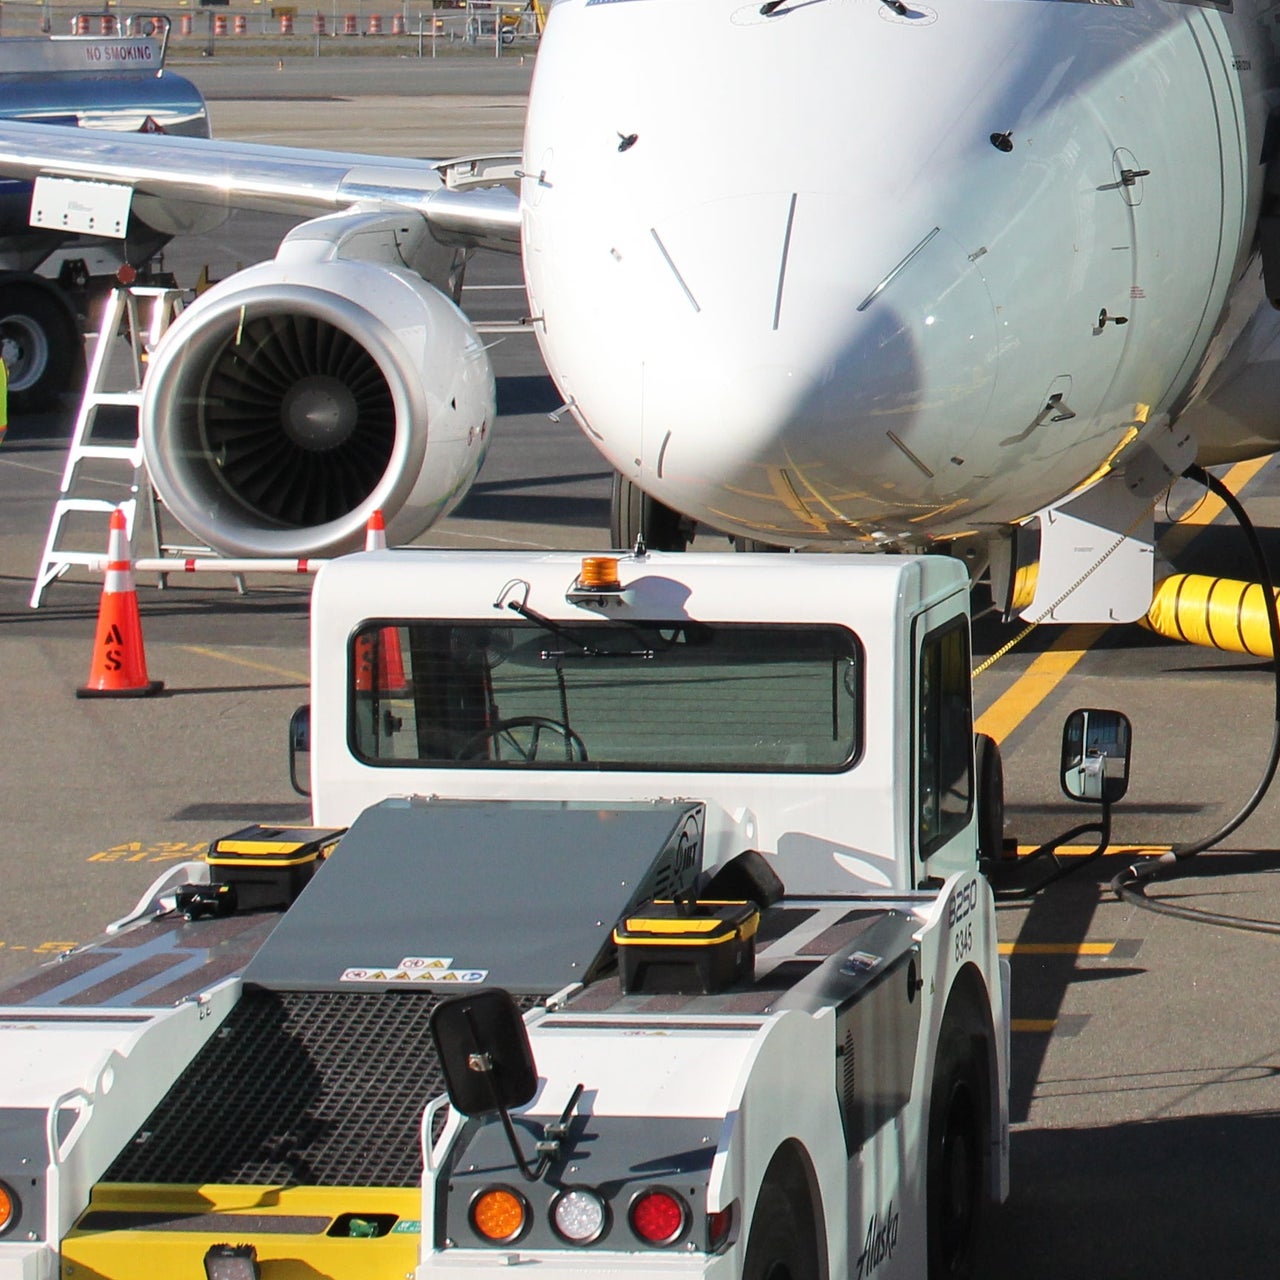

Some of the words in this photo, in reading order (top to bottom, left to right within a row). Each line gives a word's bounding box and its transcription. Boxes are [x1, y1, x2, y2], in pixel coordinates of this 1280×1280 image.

[86, 47, 101, 60] NO
[105, 45, 152, 60] SMOKING
[948, 878, 977, 930] B250
[955, 921, 972, 962] 8345
[856, 1199, 899, 1280] Alaska
